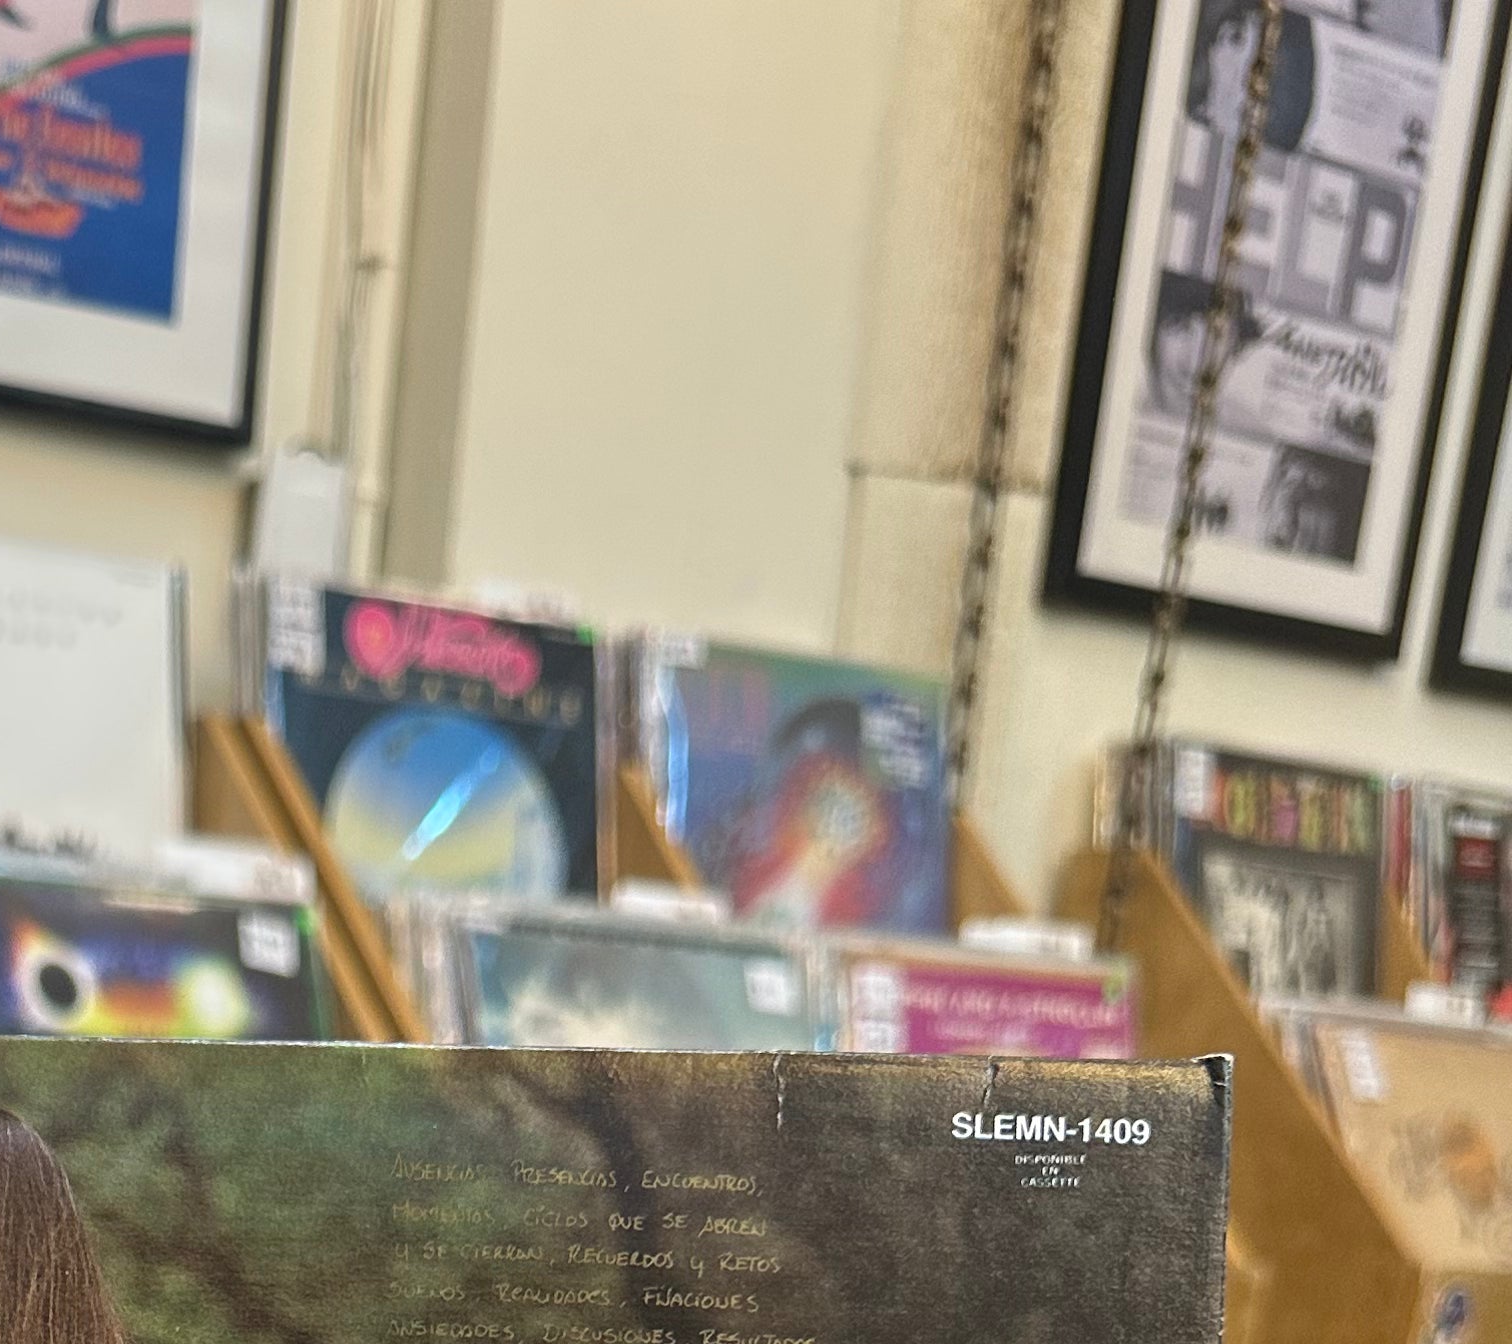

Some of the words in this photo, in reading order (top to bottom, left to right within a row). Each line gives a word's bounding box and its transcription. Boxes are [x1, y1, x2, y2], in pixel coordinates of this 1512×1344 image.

[951, 1111, 1152, 1146] SLEMN-1409
[1014, 1153, 1088, 1166] DISPONIBLE
[1041, 1166, 1059, 1177] EN
[1020, 1176, 1081, 1189] CASSETTE
